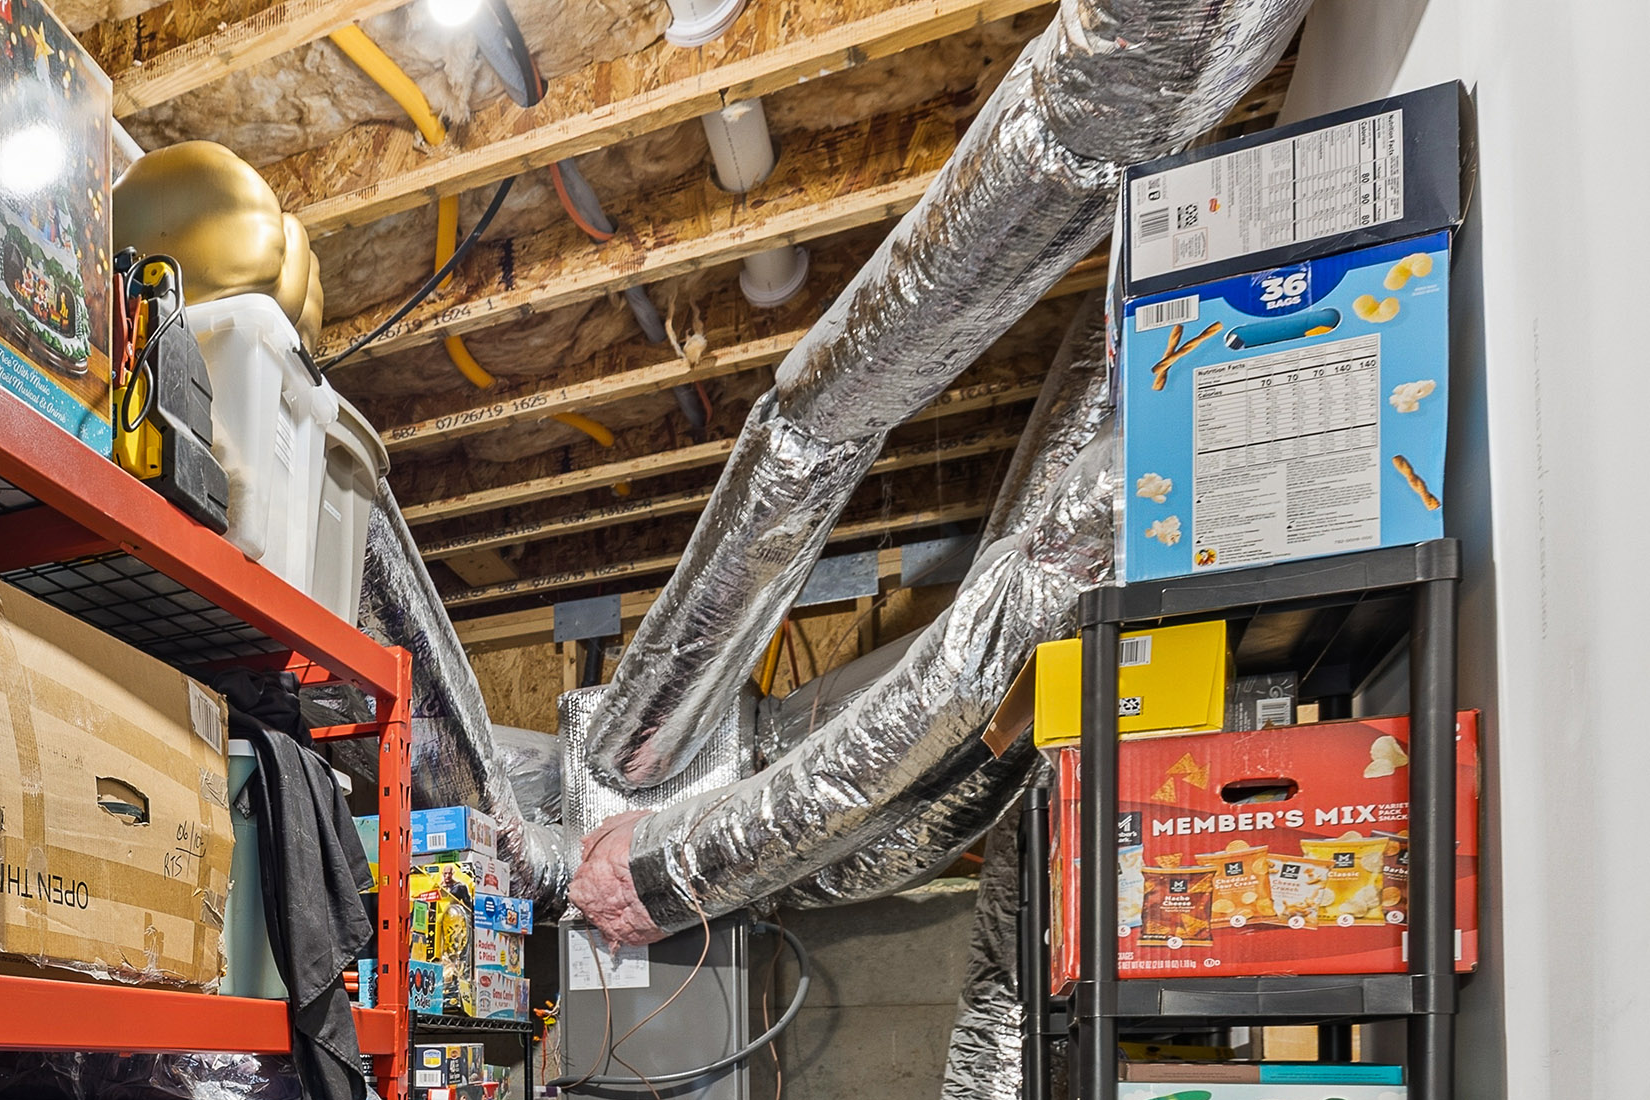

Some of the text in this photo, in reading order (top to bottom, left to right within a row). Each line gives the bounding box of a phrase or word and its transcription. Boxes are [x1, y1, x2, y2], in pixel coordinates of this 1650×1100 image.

[1362, 173, 1369, 183] 80
[1362, 194, 1369, 204] 90
[1362, 215, 1369, 225] 80
[1260, 273, 1307, 301] 36
[1266, 297, 1301, 310] BAGS
[433, 305, 471, 326] 1624
[13, 361, 30, 380] With
[30, 371, 50, 396] Music
[1287, 374, 1298, 382] 70
[1313, 369, 1324, 377] 70
[1334, 364, 1351, 372] 140
[1359, 360, 1376, 368] 140
[13, 377, 39, 404] Musical
[435, 405, 503, 430] 07/26/19
[512, 395, 547, 413] 1625
[1152, 804, 1377, 837] MEMBER'S MIX
[37, 871, 89, 909] OPEN
[1215, 875, 1250, 885] Cheddar
[1233, 879, 1259, 888] Cream
